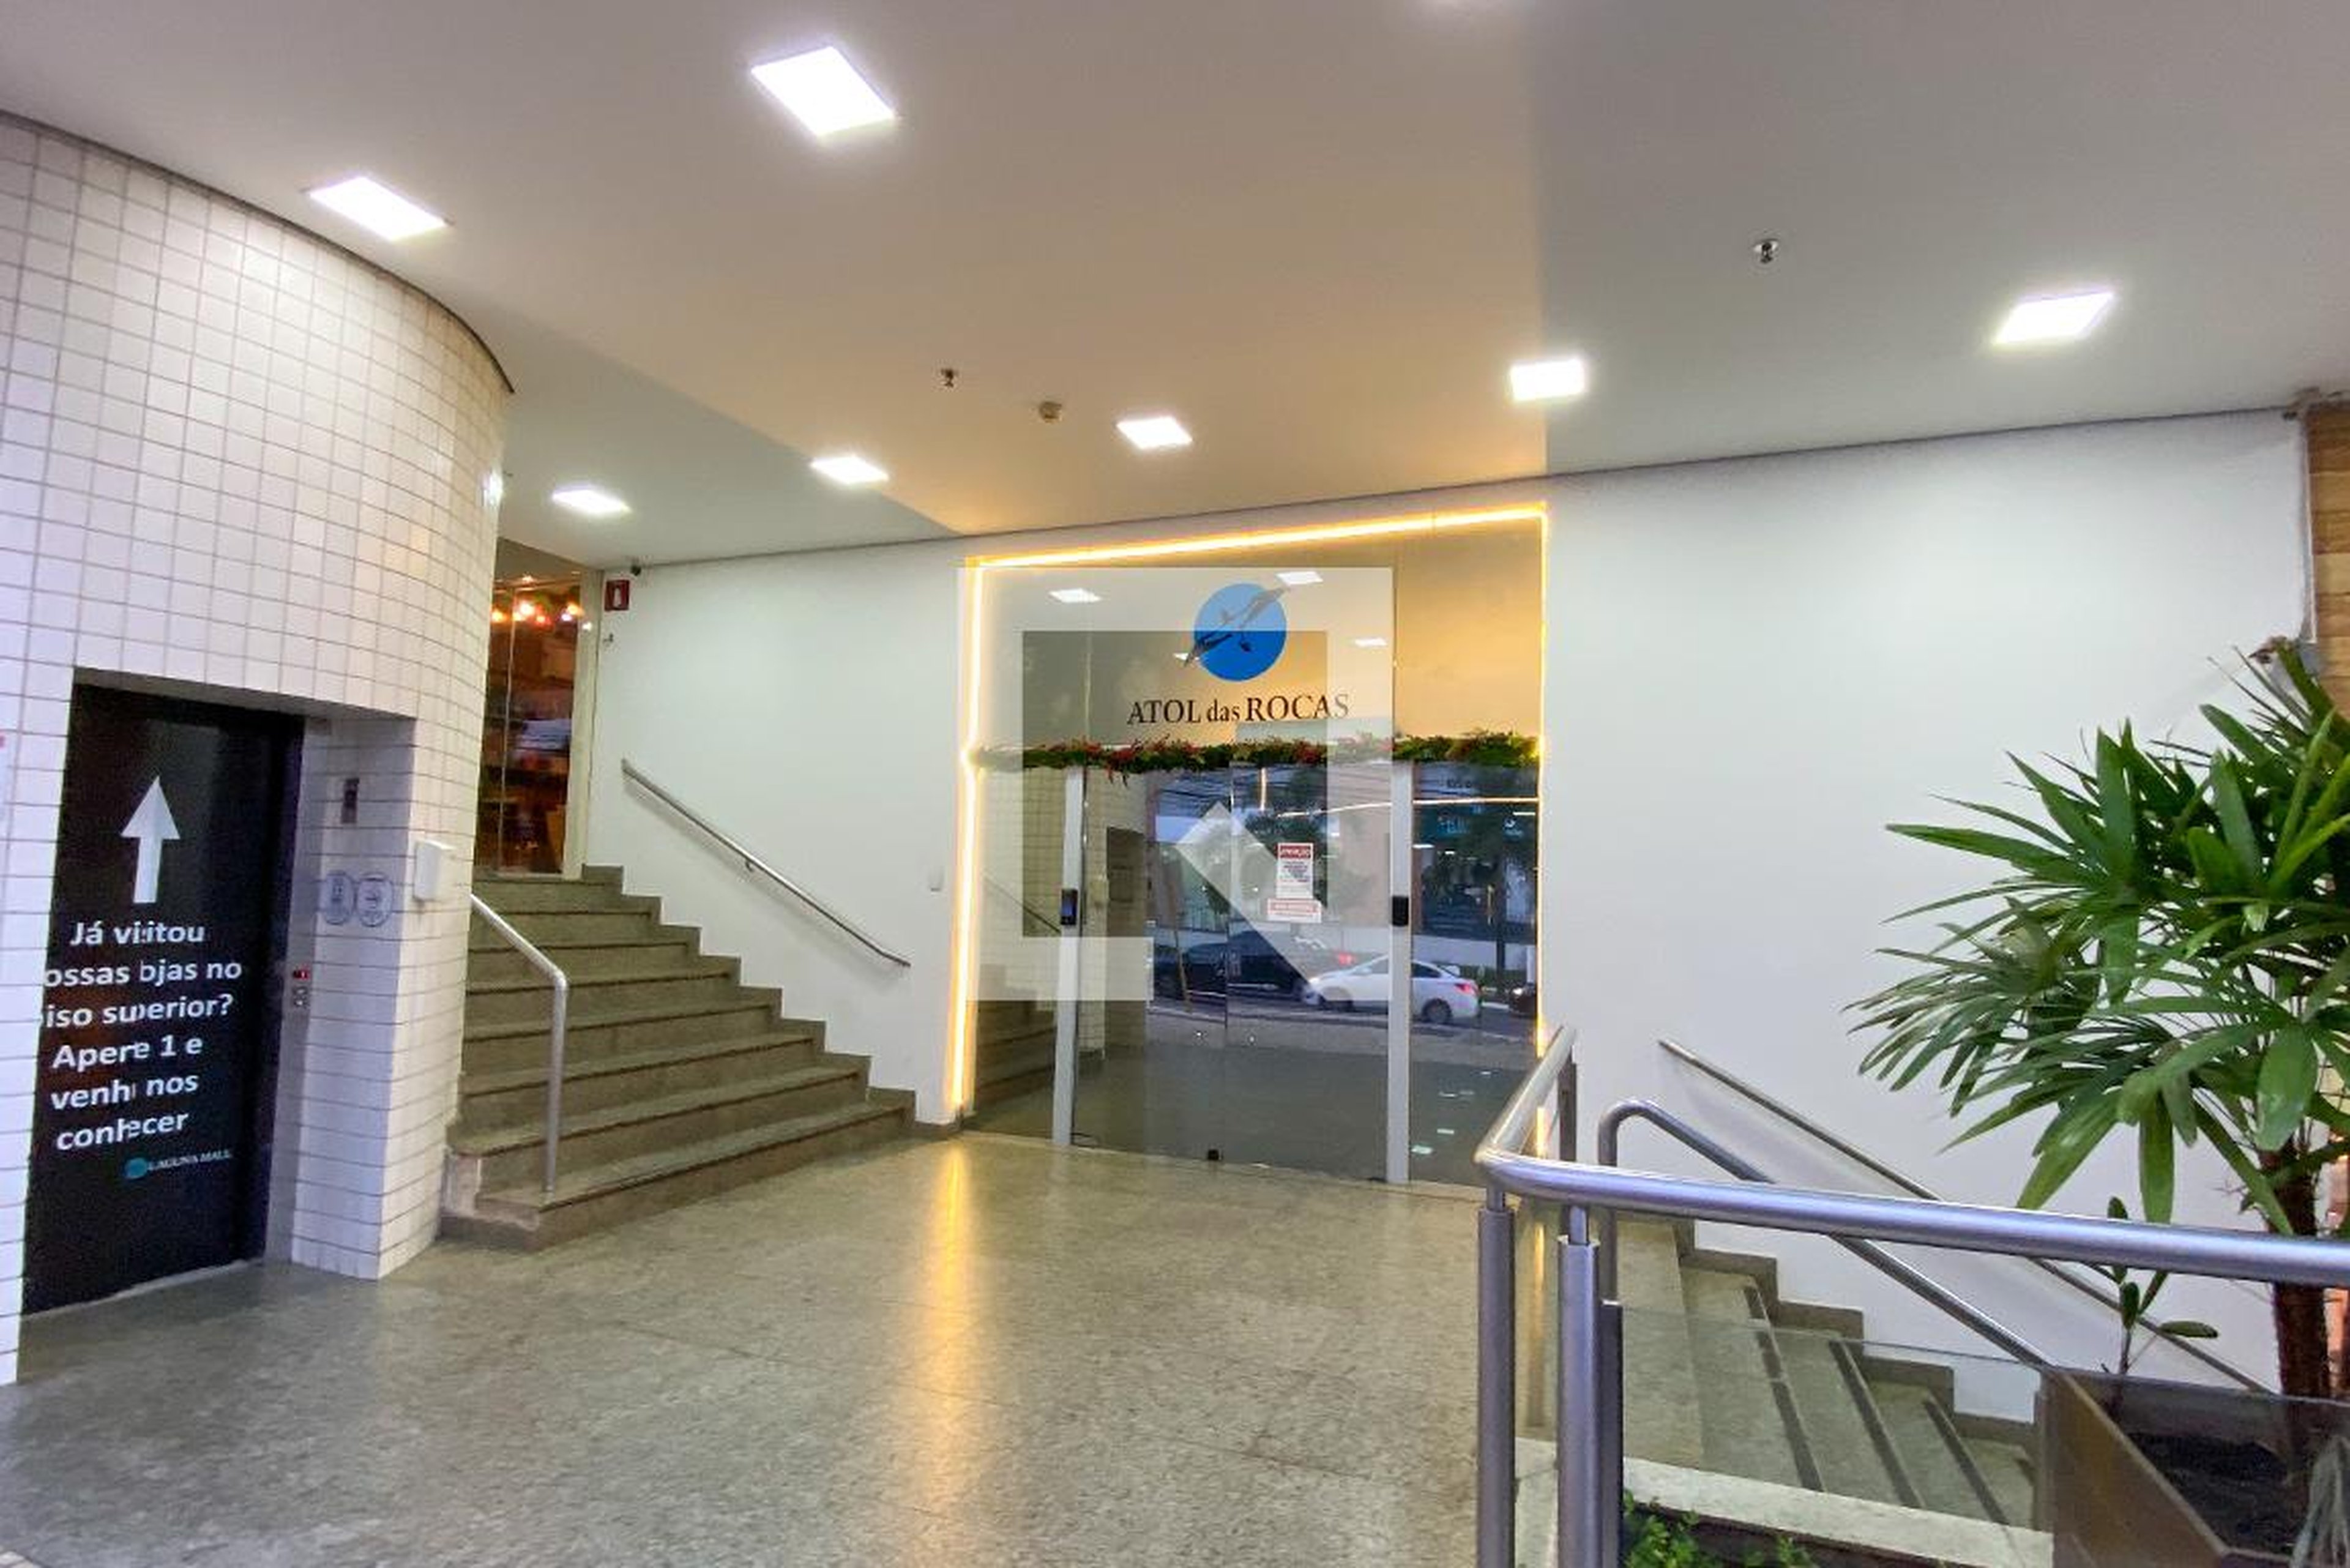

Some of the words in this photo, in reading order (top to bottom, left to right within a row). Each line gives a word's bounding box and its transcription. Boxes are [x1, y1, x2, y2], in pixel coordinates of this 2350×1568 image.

[1127, 699, 1201, 724] ATOL
[1206, 699, 1240, 722] das
[1245, 693, 1349, 722] ROCAS
[70, 920, 103, 946] Já
[206, 962, 242, 979] no
[160, 1034, 176, 1057] 1
[186, 1036, 203, 1055] e
[51, 1080, 136, 1110] venh
[145, 1074, 200, 1096] nos
